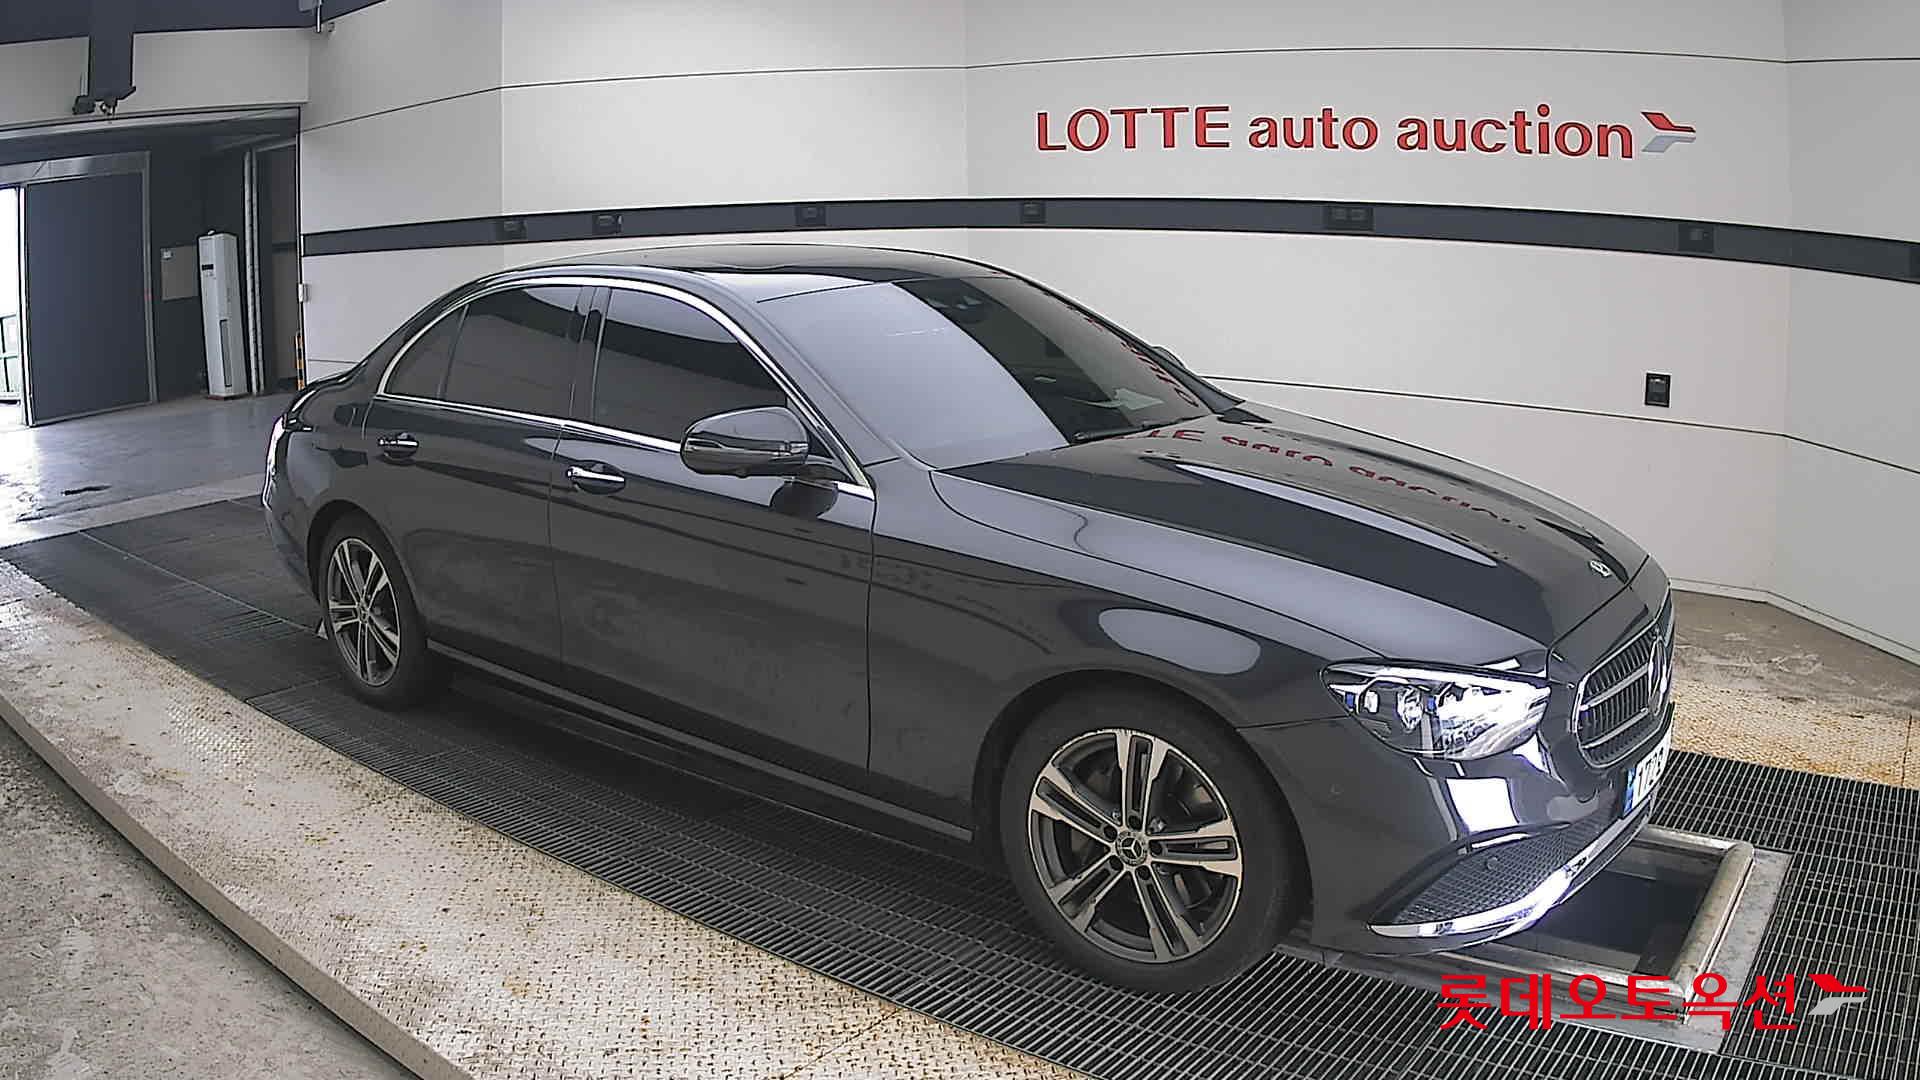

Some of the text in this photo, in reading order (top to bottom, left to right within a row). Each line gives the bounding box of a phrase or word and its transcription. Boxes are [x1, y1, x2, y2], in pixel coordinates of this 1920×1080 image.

[1038, 103, 1634, 159] LOTTE auto auction
